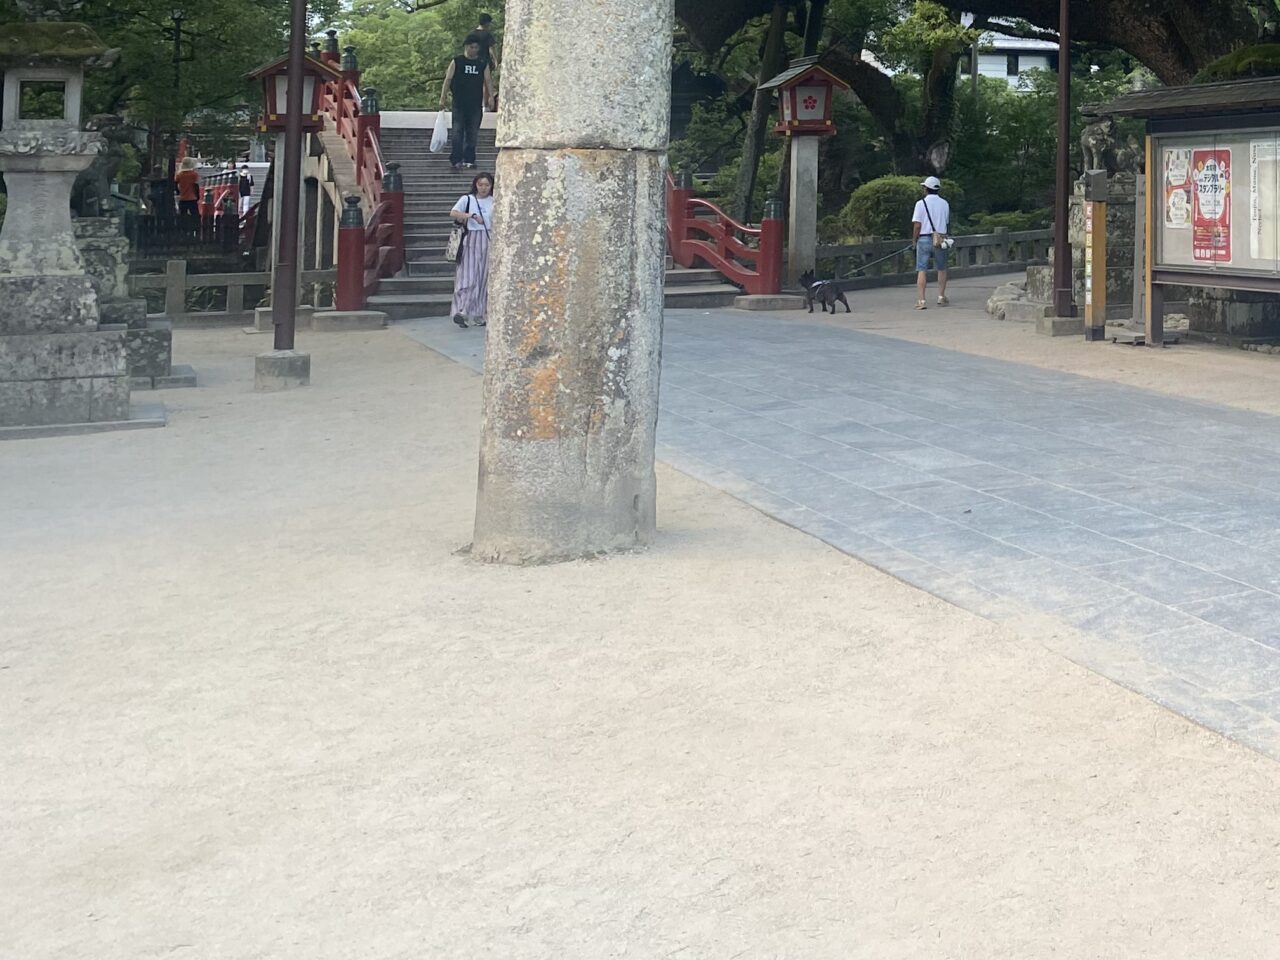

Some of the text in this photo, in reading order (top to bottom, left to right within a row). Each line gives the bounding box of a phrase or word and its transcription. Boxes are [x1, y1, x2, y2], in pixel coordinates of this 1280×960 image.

[464, 65, 479, 74] RL
[1204, 173, 1219, 183] デジタル
[1199, 184, 1224, 194] スタンプラリー
